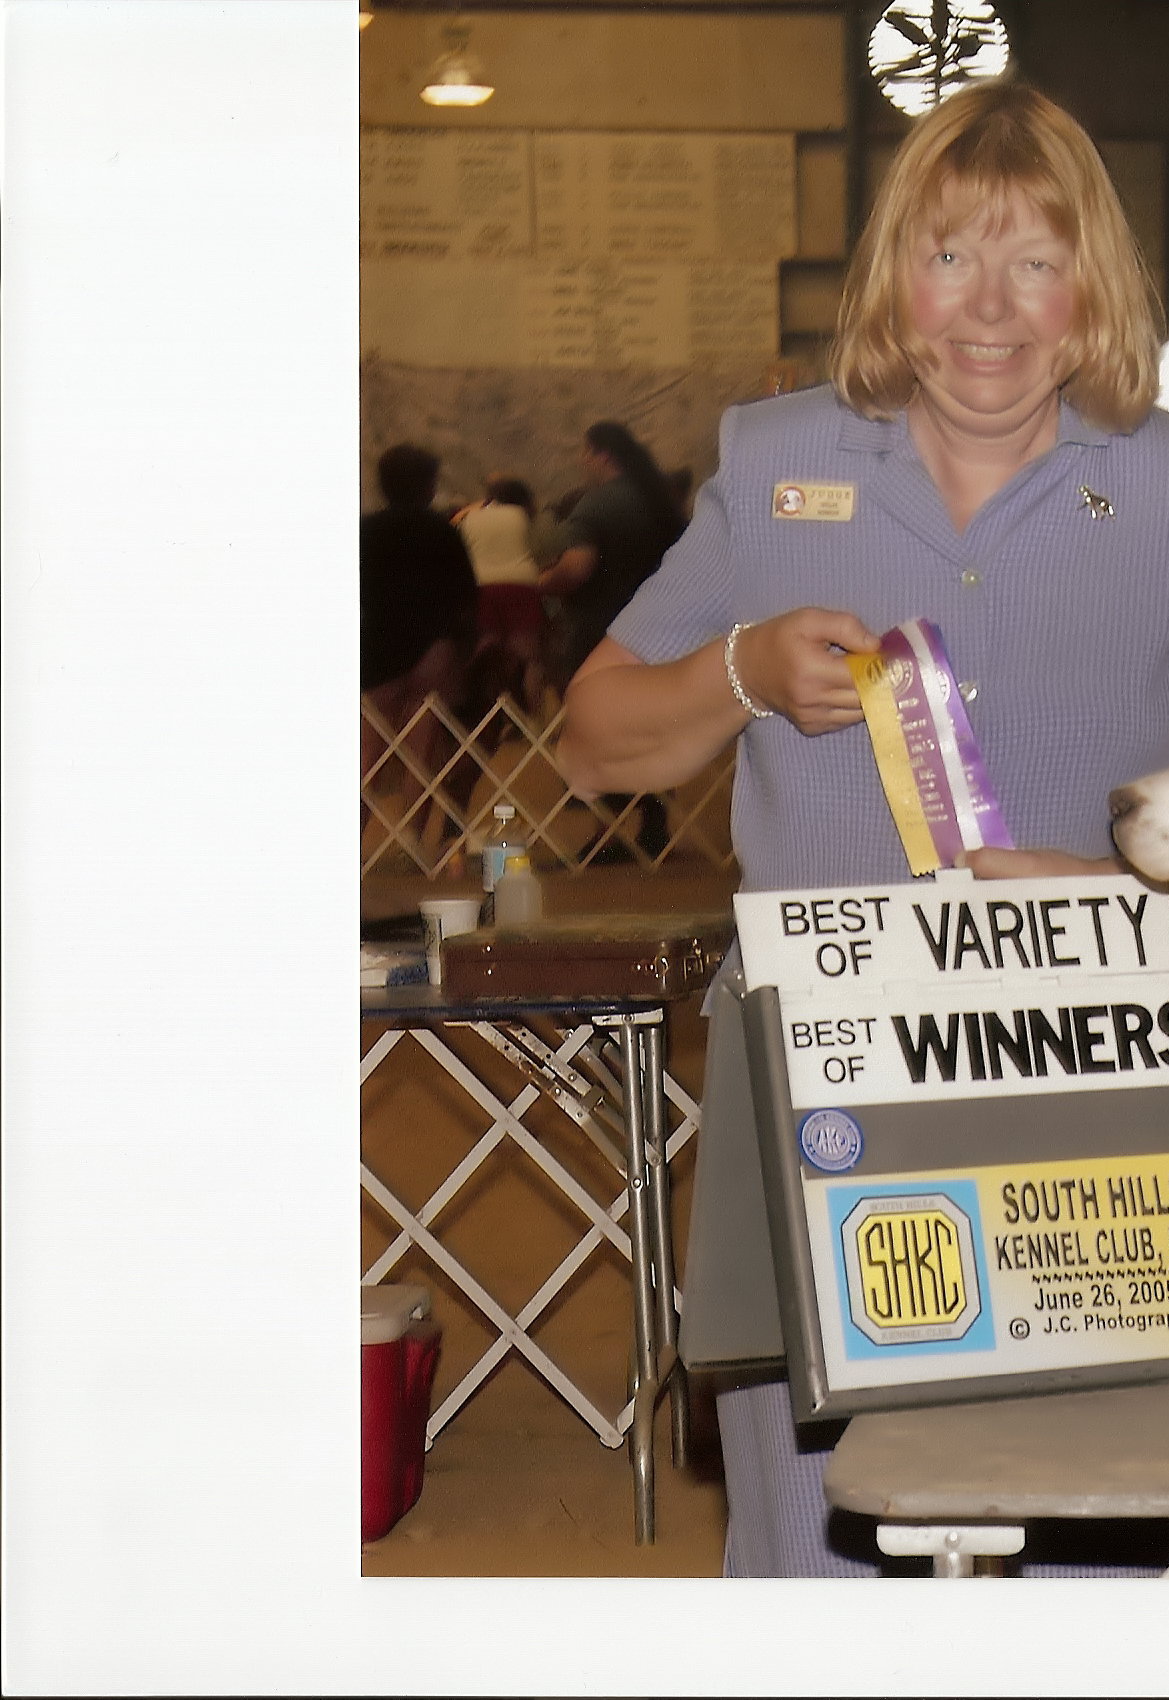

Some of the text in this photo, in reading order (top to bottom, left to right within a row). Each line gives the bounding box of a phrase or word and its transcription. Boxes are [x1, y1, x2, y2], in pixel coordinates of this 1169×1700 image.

[780, 896, 889, 936] BEST
[912, 894, 1149, 971] VARIETY
[816, 940, 872, 977] OF
[791, 1018, 877, 1049] BEST
[823, 1055, 865, 1083] OF
[1002, 1177, 1099, 1224] SOUTH
[995, 1231, 1089, 1271] KENNEL
[1096, 1225, 1164, 1270] CLUB,
[865, 1218, 960, 1318] SHKC
[1034, 1287, 1083, 1311] June
[1091, 1283, 1122, 1313] 26,
[1043, 1316, 1077, 1334] J.C.
